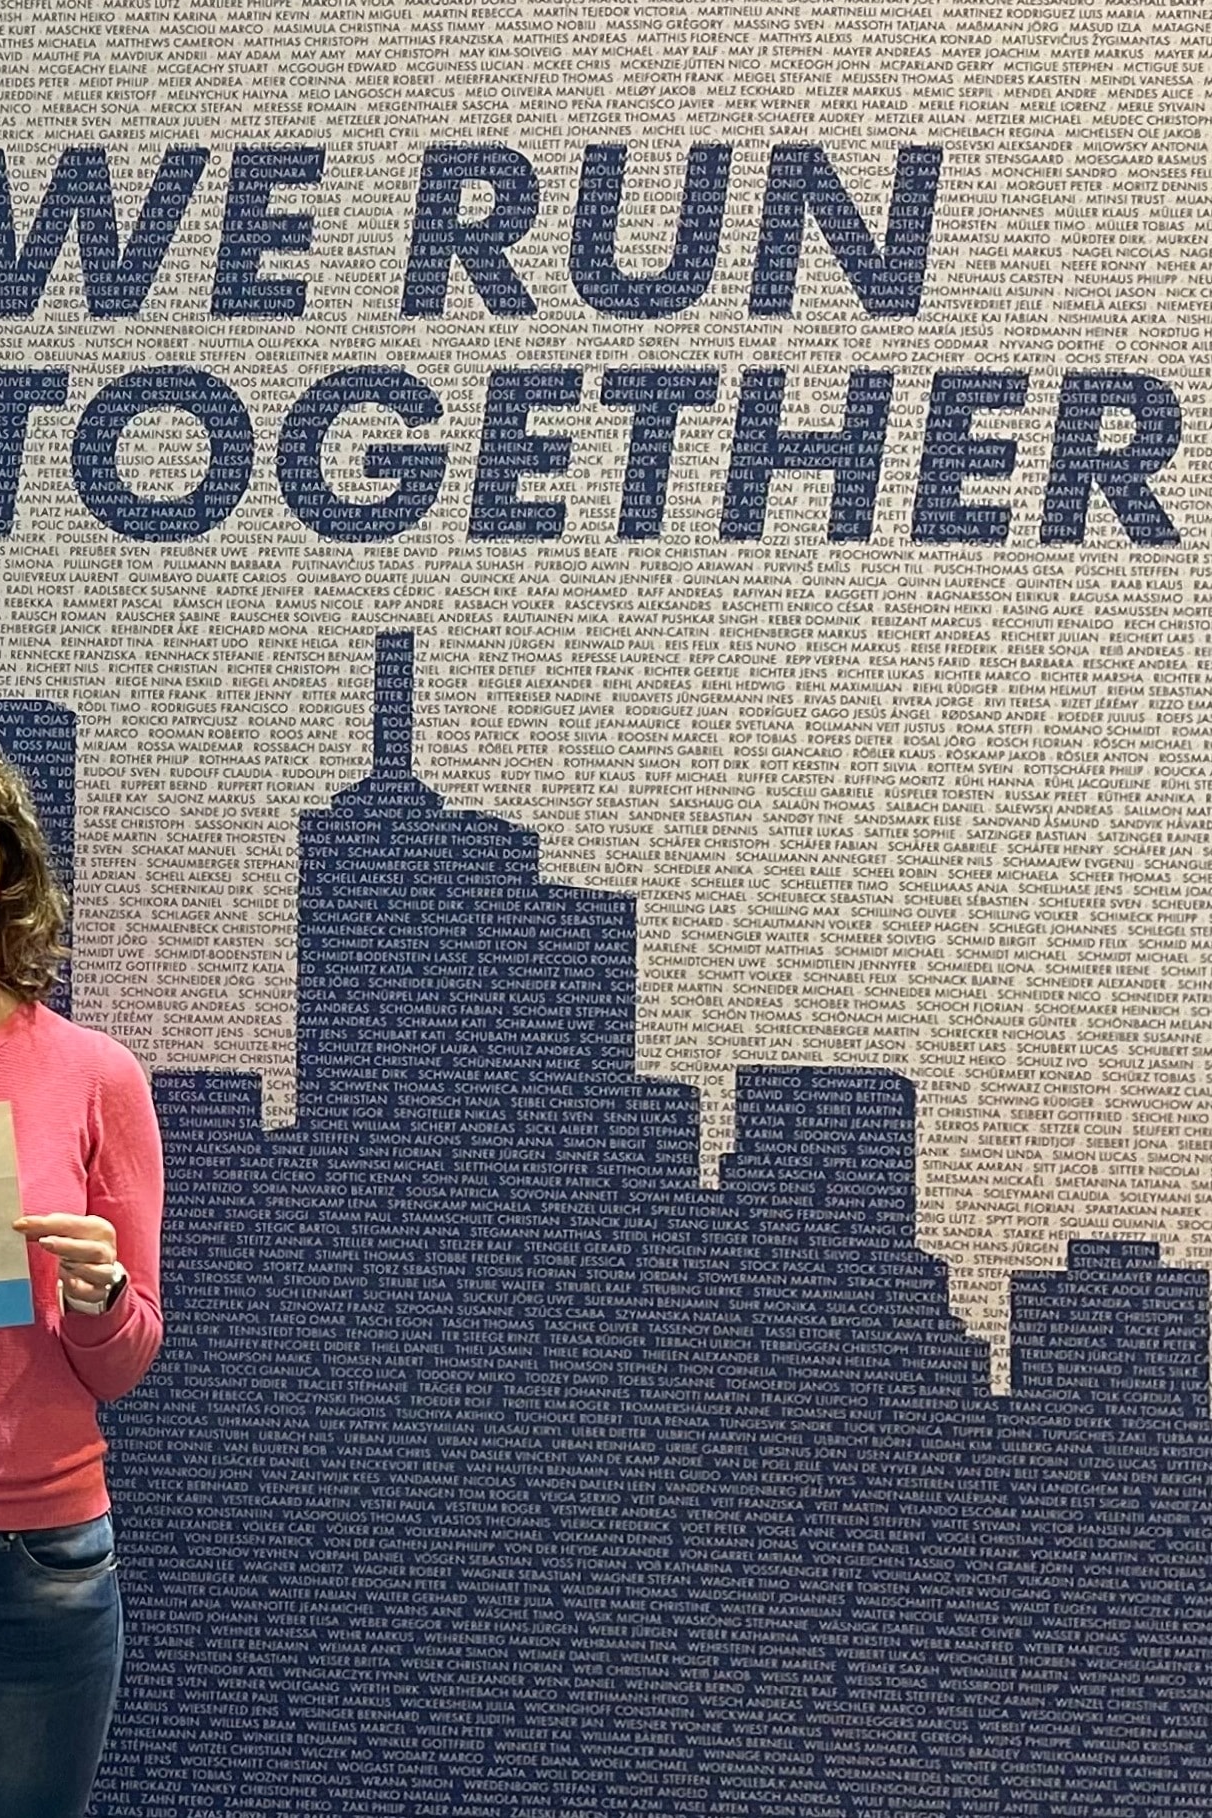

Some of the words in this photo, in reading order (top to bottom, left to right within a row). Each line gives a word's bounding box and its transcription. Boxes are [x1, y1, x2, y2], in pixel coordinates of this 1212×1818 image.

[290, 49, 318, 60] MAY
[318, 49, 347, 61] AMY
[355, 48, 383, 60] MAY
[384, 47, 450, 60] CHRISTOPH
[941, 47, 981, 59] MAYER
[983, 47, 1040, 60] JOACHIM
[298, 88, 331, 100] MELO
[334, 87, 402, 100] LANGOSCH
[404, 87, 456, 99] MARCUS
[918, 100, 955, 111] MERLE
[958, 100, 1010, 112] FLORIAN
[1019, 100, 1057, 112] MERLE
[1060, 101, 1107, 113] LORENZ
[400, 144, 944, 318] RUN
[230, 611, 290, 623] RAUSCHER
[292, 611, 342, 623] SOLVEIG
[768, 614, 802, 626] REBER
[804, 614, 862, 626] DOMINIK
[163, 637, 219, 648] REINHART
[220, 637, 249, 649] UDO
[258, 638, 298, 649] REINKE
[300, 638, 339, 649] HELGA
[837, 668, 885, 680] RICHTER
[886, 669, 925, 680] LUKAS
[934, 669, 982, 681] RICHTER
[984, 670, 1032, 682] MARCO
[169, 767, 220, 779] RUDOLFF
[222, 767, 274, 779] CLAUDIA
[166, 831, 223, 844] SCHAEFER
[225, 832, 286, 844] THORSTEN
[130, 844, 185, 856] SCHAKAT
[187, 845, 237, 857] MANUEL
[851, 866, 896, 879] SCHEEL
[898, 867, 938, 879] ROBIN
[850, 906, 914, 919] SCHILLING
[915, 907, 957, 920] OLIVER
[946, 934, 996, 947] SCHMID
[999, 936, 1037, 948] BIRGIT
[324, 963, 377, 976] SCHMITZ
[379, 963, 415, 976] KATJA
[422, 964, 475, 977] SCHMITZ
[477, 965, 500, 977] LEA
[864, 985, 932, 998] SCHNEIDER
[934, 988, 988, 1000] MICHAEL
[997, 988, 1065, 1002] SCHNEIDER
[1067, 990, 1102, 1002] NICO
[379, 1003, 458, 1016] SCHOMBURG
[459, 1004, 504, 1016] FABIAN
[919, 1053, 966, 1066] SCHULZ
[968, 1054, 1008, 1066] HEIKO
[628, 1191, 670, 1203] SOYAH
[673, 1192, 725, 1205] MELANIE
[317, 1210, 362, 1222] STAMM
[363, 1211, 393, 1223] PAUL
[350, 1224, 421, 1236] STEGMANN
[422, 1226, 461, 1238] ANNA
[667, 1218, 710, 1231] STANG
[711, 1220, 750, 1232] LUKAS
[759, 1220, 803, 1233] STANG
[804, 1222, 842, 1235] MARC
[314, 1249, 361, 1261] STIMPEL
[363, 1250, 415, 1263] THOMAS
[336, 1445, 363, 1457] VAN
[365, 1446, 394, 1457] DAM
[395, 1446, 432, 1459] CHRIS
[221, 1494, 303, 1507] VESTERGAARD
[304, 1497, 351, 1509] MARTIN
